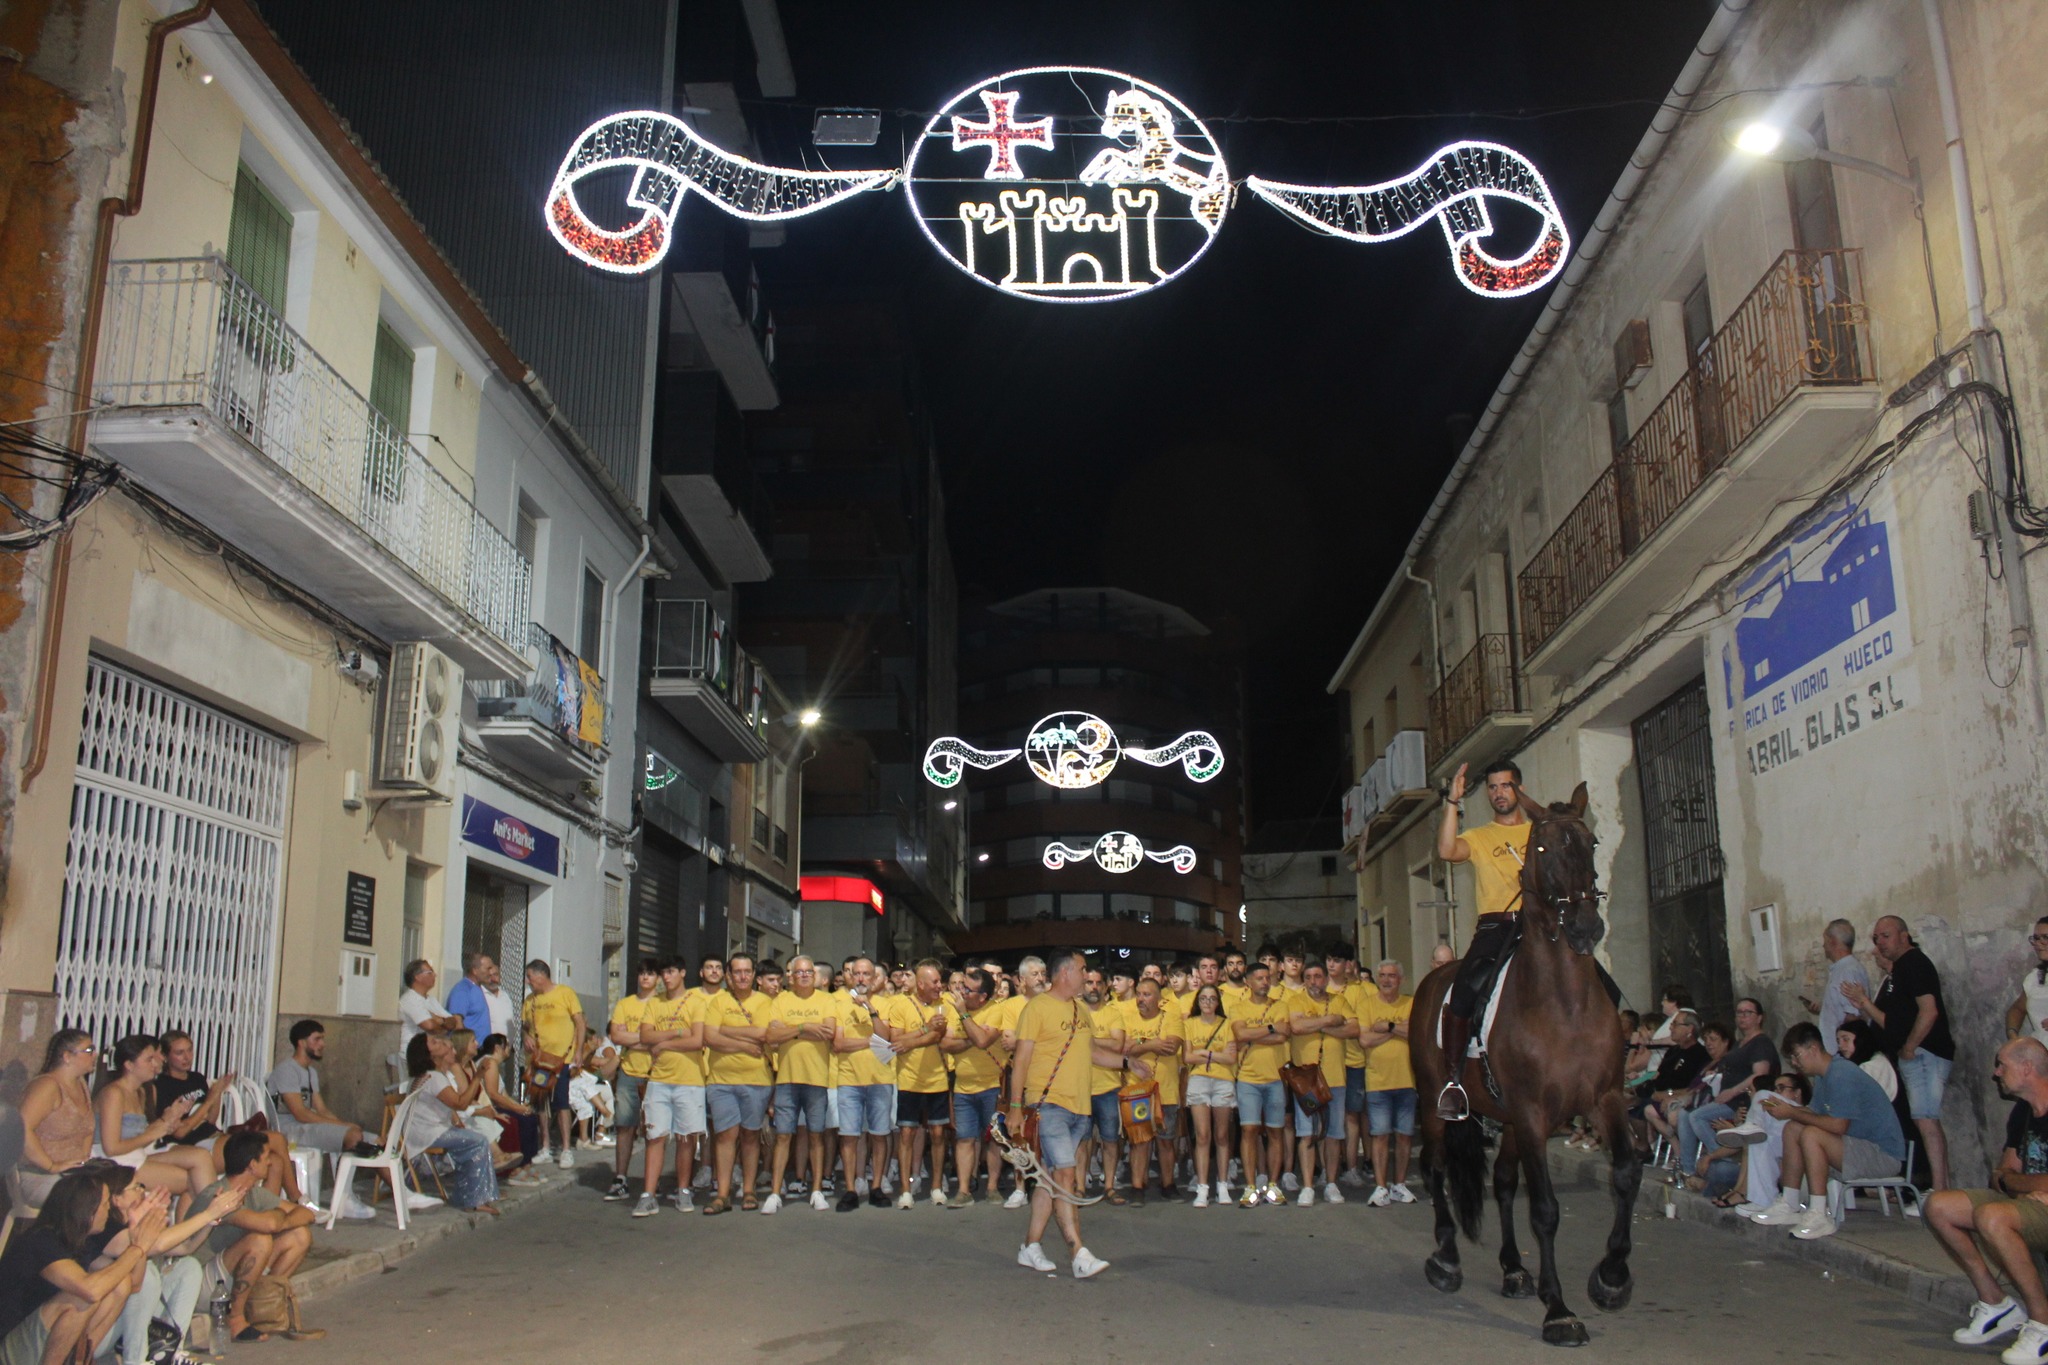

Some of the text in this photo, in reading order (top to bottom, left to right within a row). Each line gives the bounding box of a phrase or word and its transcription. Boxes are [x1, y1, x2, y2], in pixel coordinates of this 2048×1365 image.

[1772, 690, 1787, 716] DE
[1791, 667, 1829, 705] VIDRIO
[1843, 630, 1894, 677] HUECO
[511, 827, 535, 852] Market
